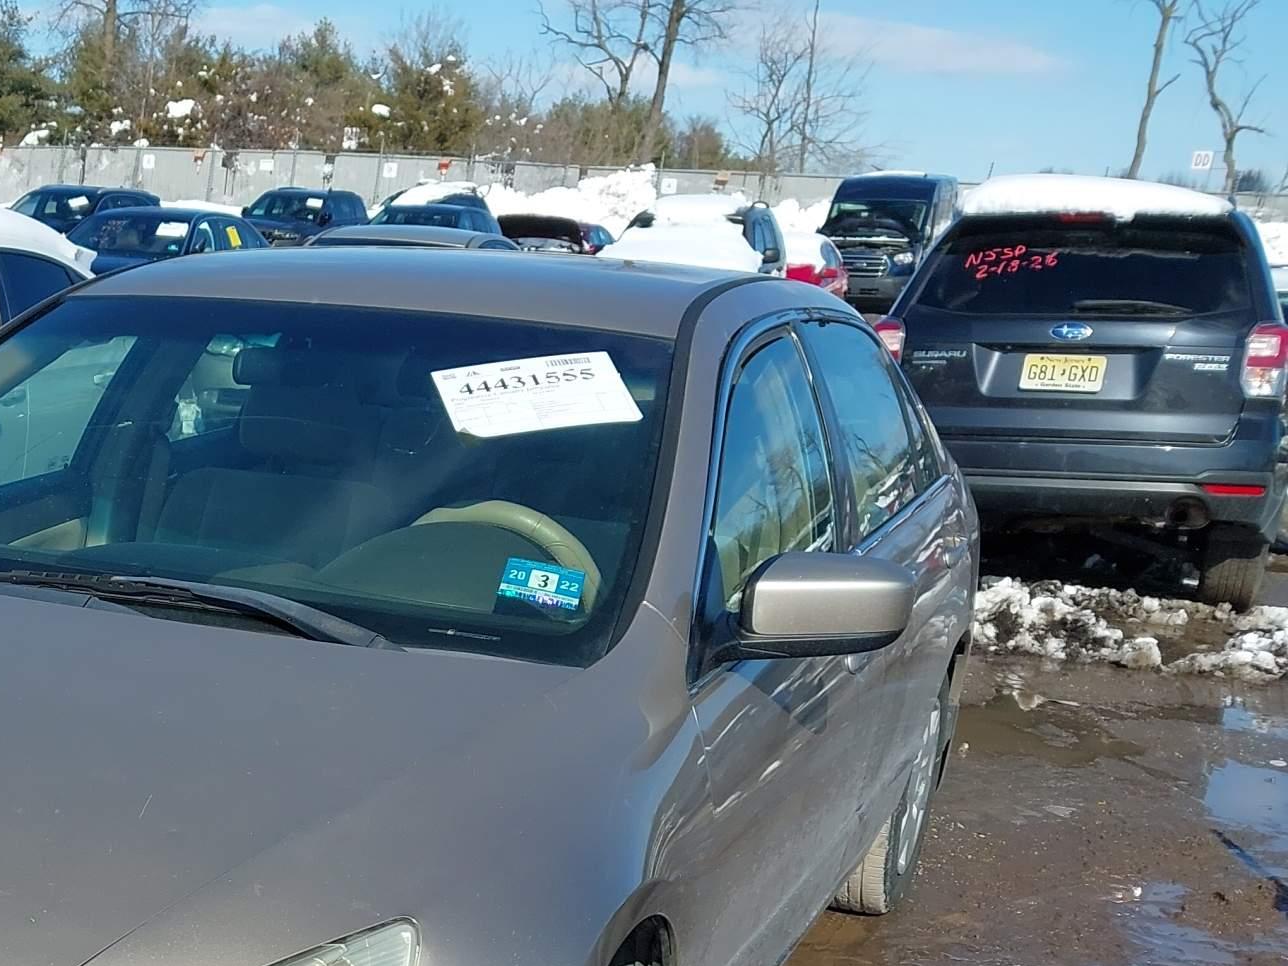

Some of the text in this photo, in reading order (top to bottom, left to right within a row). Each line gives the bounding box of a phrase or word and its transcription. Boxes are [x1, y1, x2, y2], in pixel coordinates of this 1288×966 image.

[912, 350, 968, 358] SUBARU
[1163, 353, 1232, 362] FORESTER
[459, 368, 596, 395] 44431555
[1027, 364, 1099, 382] G81 GXD
[509, 569, 580, 592] 20 3 22
